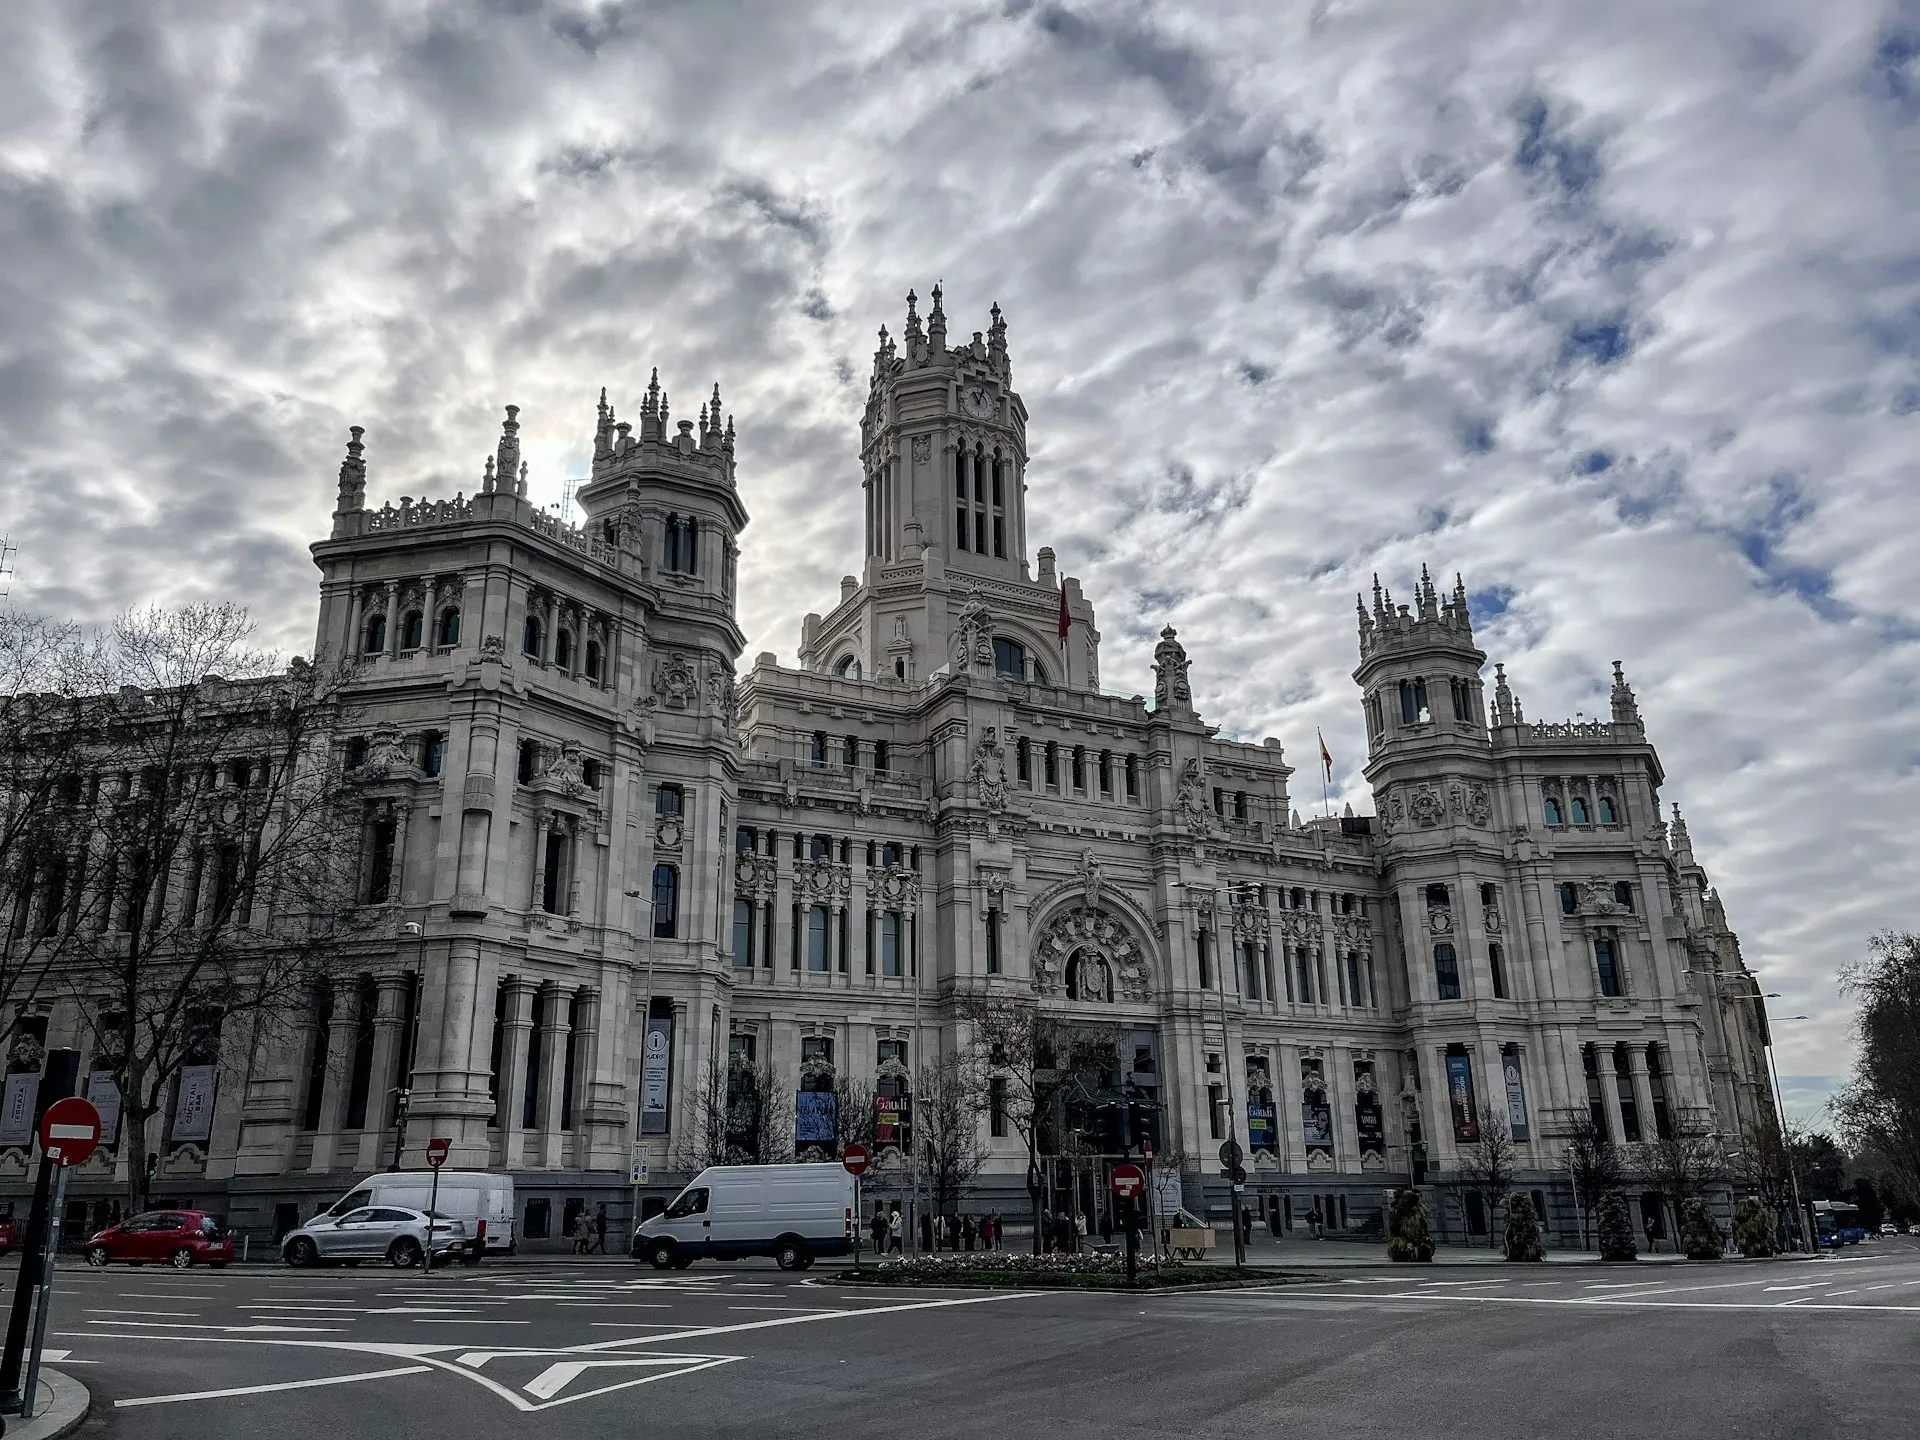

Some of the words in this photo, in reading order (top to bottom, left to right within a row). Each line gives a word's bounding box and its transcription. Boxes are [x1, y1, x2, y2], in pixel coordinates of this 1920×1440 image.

[14, 1087, 24, 1124] TERRAZA
[186, 1082, 197, 1124] COCKTAIL
[195, 1094, 203, 1111] BAR
[876, 1097, 908, 1111] Gaudí
